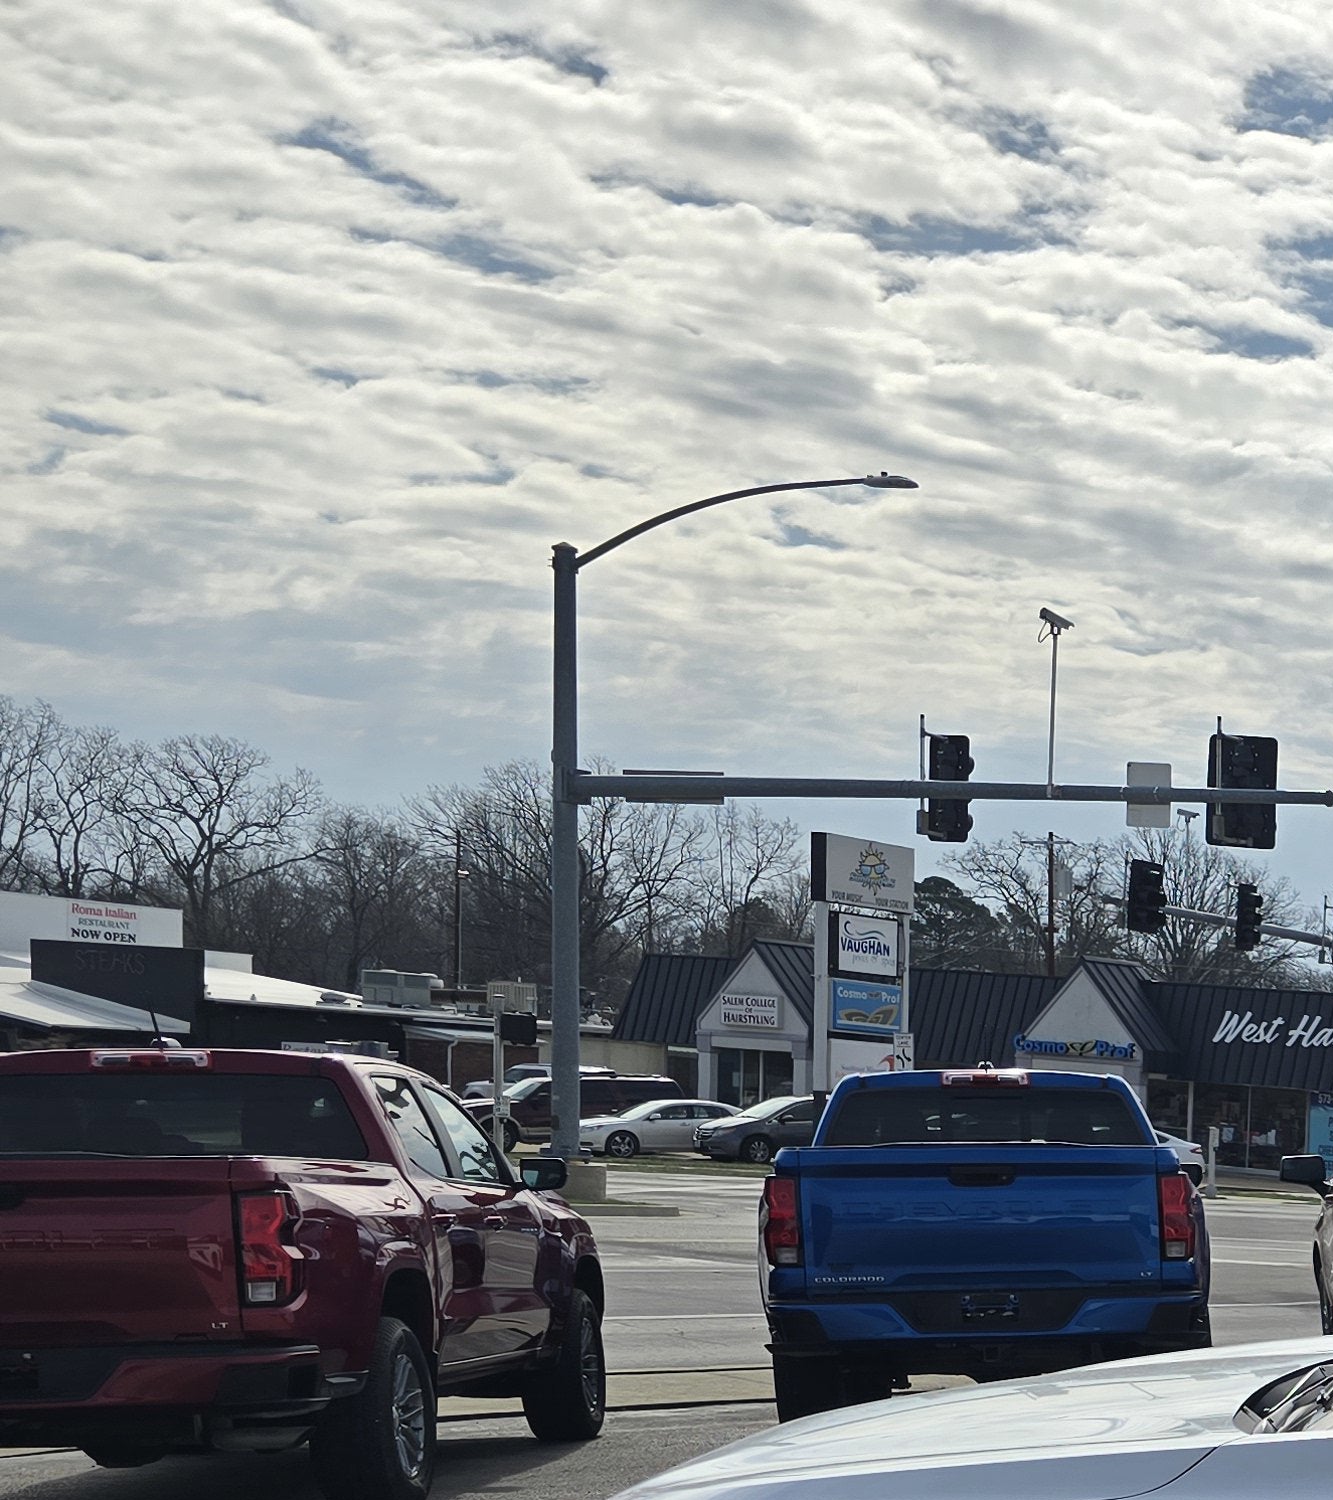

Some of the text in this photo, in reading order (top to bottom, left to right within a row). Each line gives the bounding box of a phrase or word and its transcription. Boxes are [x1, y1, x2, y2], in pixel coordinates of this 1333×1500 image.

[71, 902, 137, 920] Roma Italian
[78, 917, 130, 930] RESTAURANT
[70, 927, 137, 943] NOW OPEN
[840, 936, 890, 957] VAUGHAN
[837, 986, 868, 1000] Cosmo
[722, 995, 776, 1008] SALEM COLLEGE
[723, 1011, 775, 1026] HAIRSTYLING
[1212, 1010, 1285, 1044] West
[1013, 1032, 1136, 1059] Cosmo Prof
[814, 1275, 885, 1284] COLORADO
[210, 1321, 229, 1329] LT
